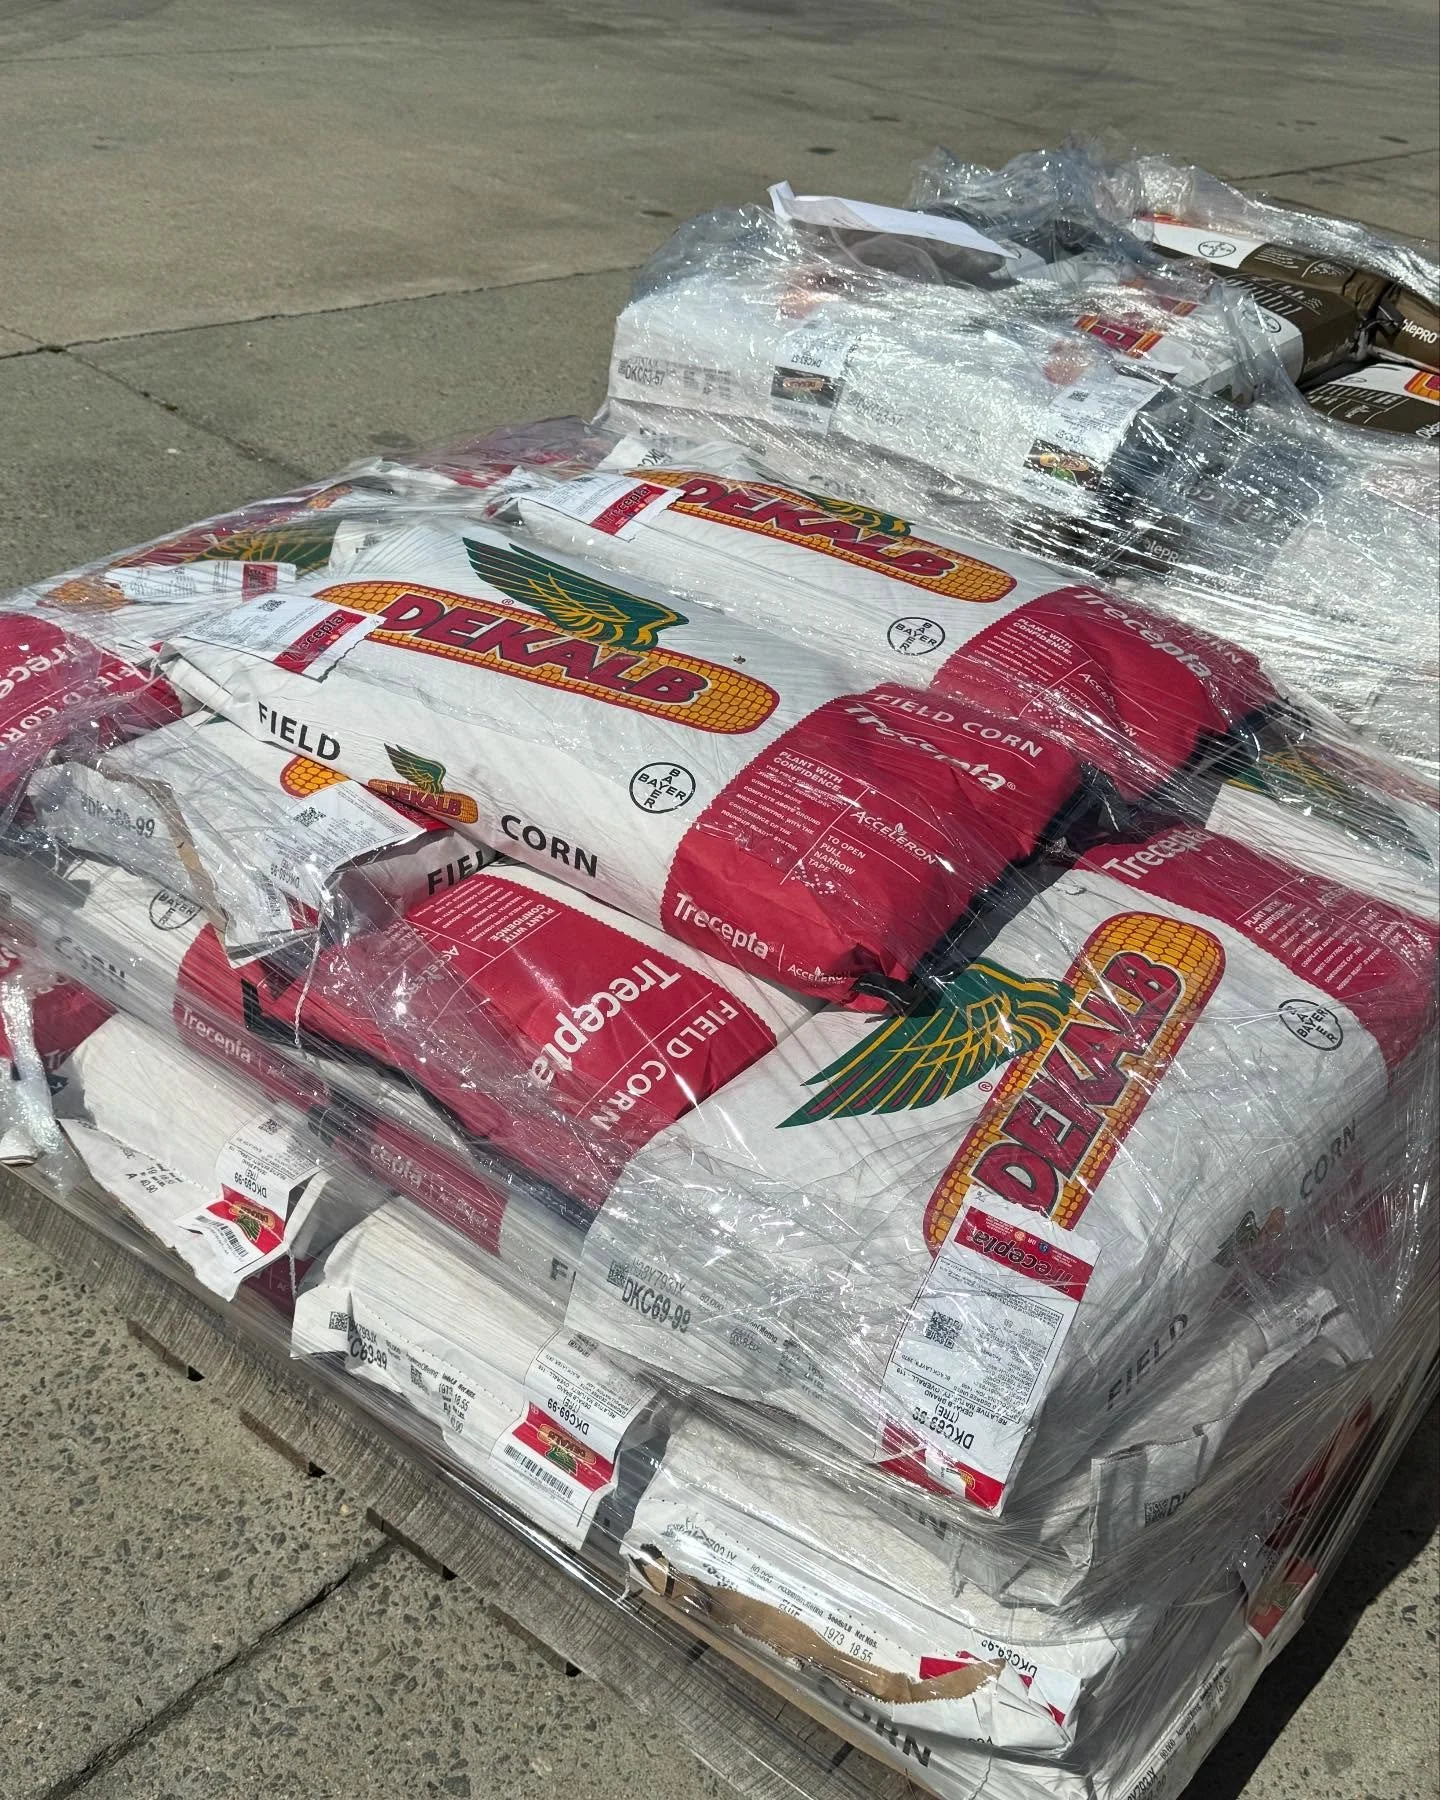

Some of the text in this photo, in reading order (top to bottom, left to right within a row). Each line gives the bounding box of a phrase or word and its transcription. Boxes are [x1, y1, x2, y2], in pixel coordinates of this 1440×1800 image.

[379, 592, 709, 704] DEKALB
[1072, 589, 1212, 678] Trecepta
[257, 700, 342, 762] FIELD
[872, 692, 1044, 759] FIELD CORN
[779, 751, 843, 783] PLANT WITH
[386, 785, 462, 817] DEKALB
[638, 772, 686, 801] BAYER
[744, 785, 821, 826] COMPLETE ABOVE GROUND
[758, 804, 785, 820] CONTROL
[500, 814, 598, 879] CORN
[820, 842, 842, 857] PULL
[827, 835, 866, 859] TO OPEN
[850, 811, 937, 865] ACCELERON
[808, 858, 831, 873] TAPE
[813, 851, 856, 875] NARROW
[529, 959, 682, 1089] Trecepta
[1296, 1007, 1328, 1038] BAYER
[590, 1000, 739, 1132] FIELD CORN
[971, 950, 1184, 1218] DEKALB
[1026, 1236, 1037, 1245] OR
[621, 1277, 692, 1333] DKC69-99
[545, 1396, 589, 1435] DKC69-99
[560, 1395, 581, 1413] (TRE)
[593, 1401, 616, 1418] RELATIVE
[932, 1402, 960, 1424] (TRE)
[974, 1405, 1007, 1426] RELATIVE
[546, 1429, 588, 1458] DEKALB
[820, 1624, 847, 1647] 1973
